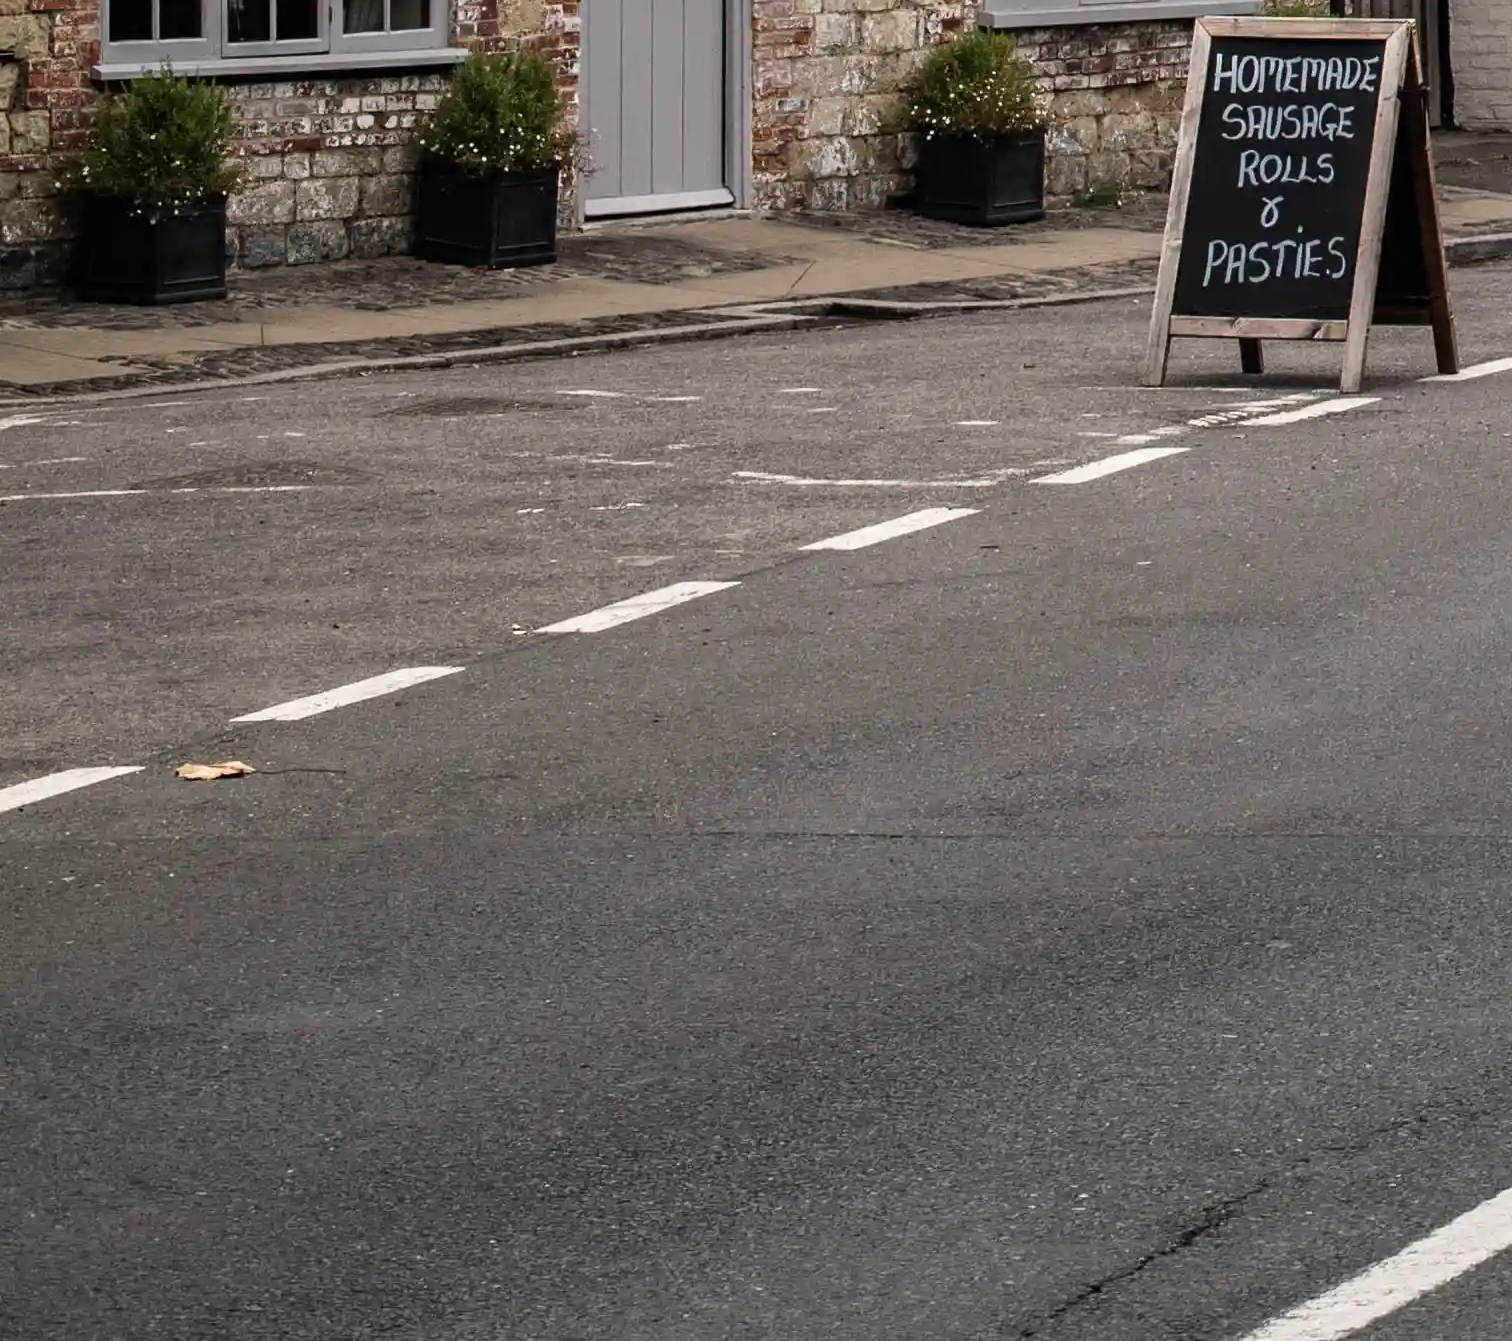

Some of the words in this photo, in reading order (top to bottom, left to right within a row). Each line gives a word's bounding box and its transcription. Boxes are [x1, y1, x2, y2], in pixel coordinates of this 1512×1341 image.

[1213, 52, 1380, 94] HOMEMADE
[1221, 102, 1355, 142] SAUSAGE
[1237, 149, 1335, 188] ROLLS
[1202, 226, 1347, 288] PASTIES
